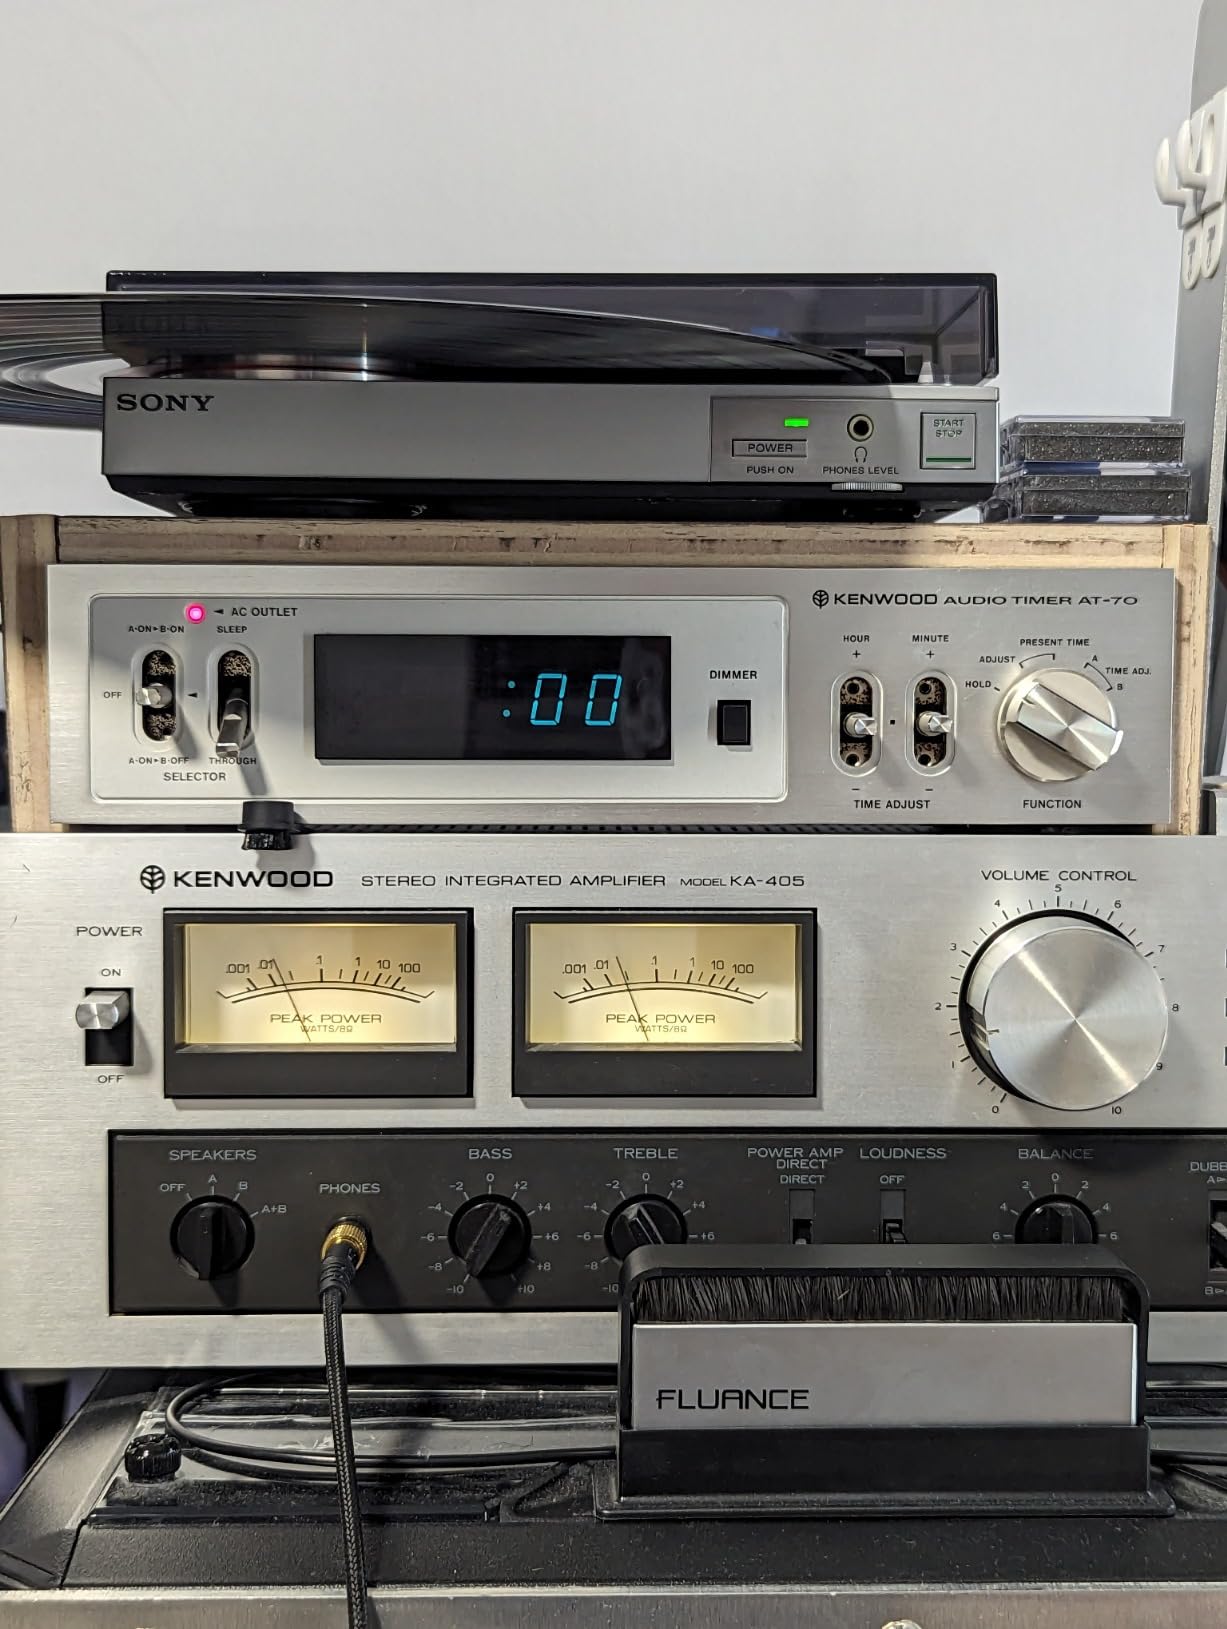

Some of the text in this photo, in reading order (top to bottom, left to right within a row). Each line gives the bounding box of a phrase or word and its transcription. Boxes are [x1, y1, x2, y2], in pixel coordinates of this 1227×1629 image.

[117, 394, 215, 411] SONY
[933, 418, 964, 427] START
[935, 429, 962, 438] STOP
[747, 444, 793, 453] POWER
[746, 466, 794, 474] PUSH ON
[823, 467, 899, 475] PHONES LEVEL
[834, 593, 1138, 605] KENWOOD AUDIO TIMER AT-70
[231, 607, 298, 617] AC OUTLET
[217, 625, 247, 634] SLEEP
[843, 635, 870, 643] HOUR
[912, 635, 949, 643] MINUTE
[1019, 638, 1090, 647] PRESENT TIME
[979, 655, 1016, 664] ADJUST
[709, 670, 758, 680] DIMMER
[1105, 667, 1128, 675] TIME
[965, 680, 992, 689] HOLD
[1117, 683, 1123, 691] B
[103, 691, 122, 699] OFF
[209, 757, 257, 765] THROUGH
[163, 772, 226, 782] SELECTOR
[854, 800, 930, 809] TIME ADJUST
[1023, 800, 1082, 809] FUNCTION
[174, 870, 334, 887] KENWOOD
[981, 870, 1137, 882] VOLUME CONTROL
[361, 875, 805, 887] STEREO INTEGRATED AMPLIFIER MODEL KA-405
[1055, 884, 1062, 893] 5
[994, 900, 1000, 908] 4
[1114, 900, 1122, 909] 6
[76, 926, 143, 937] POWER
[950, 943, 957, 951] 3
[1158, 945, 1165, 953] 7
[377, 959, 390, 970] 10
[398, 963, 421, 974] 100
[562, 963, 587, 974] .001
[593, 960, 609, 970] .01
[711, 960, 724, 970] 10
[732, 963, 754, 974] 100
[101, 968, 121, 977] ON
[935, 1002, 942, 1011] 2
[1172, 1004, 1179, 1012] 8
[270, 1014, 382, 1024] PEAK POWER
[606, 1014, 716, 1024] PEAK POWER
[1156, 1062, 1163, 1071] 9
[97, 1075, 124, 1084] OFF
[992, 1106, 999, 1114] 0
[1111, 1106, 1122, 1115] 10
[169, 1150, 257, 1161] SPEAKERS
[468, 1148, 513, 1159] BASS
[614, 1147, 679, 1159] TREBLE
[747, 1148, 844, 1158] POWER AMP
[860, 1148, 947, 1159] LOUDNESS
[1018, 1149, 1094, 1160] BALANCE
[776, 1159, 828, 1169] DIRECT
[208, 1174, 218, 1183] A
[486, 1173, 495, 1182] 0
[642, 1172, 650, 1181] 0
[779, 1175, 825, 1184] DIRECT
[879, 1175, 905, 1184] OFF
[1051, 1173, 1060, 1182] 0
[160, 1183, 186, 1192] OFF
[239, 1181, 248, 1190] B
[319, 1183, 381, 1194] PHONES
[450, 1181, 464, 1190] -2
[513, 1181, 528, 1190] +2
[605, 1180, 620, 1189] -2
[670, 1179, 684, 1189] +2
[1021, 1181, 1030, 1190] 2
[1081, 1181, 1089, 1190] 2
[428, 1202, 442, 1212] -4
[537, 1202, 551, 1212] +4
[584, 1202, 598, 1211] -4
[691, 1200, 706, 1209] +4
[1000, 1202, 1007, 1211] 4
[1102, 1202, 1110, 1211] 4
[261, 1205, 287, 1214] A+B
[420, 1233, 435, 1242] -6
[545, 1232, 560, 1242] +6
[577, 1232, 591, 1241] -6
[700, 1231, 715, 1241] +6
[992, 1232, 1000, 1240] 6
[1110, 1232, 1118, 1241] 6
[428, 1262, 443, 1272] -8
[537, 1262, 551, 1272] +8
[585, 1261, 599, 1270] -8
[447, 1284, 464, 1294] -10
[517, 1284, 535, 1294] +10
[656, 1389, 809, 1410] FLUANCE
